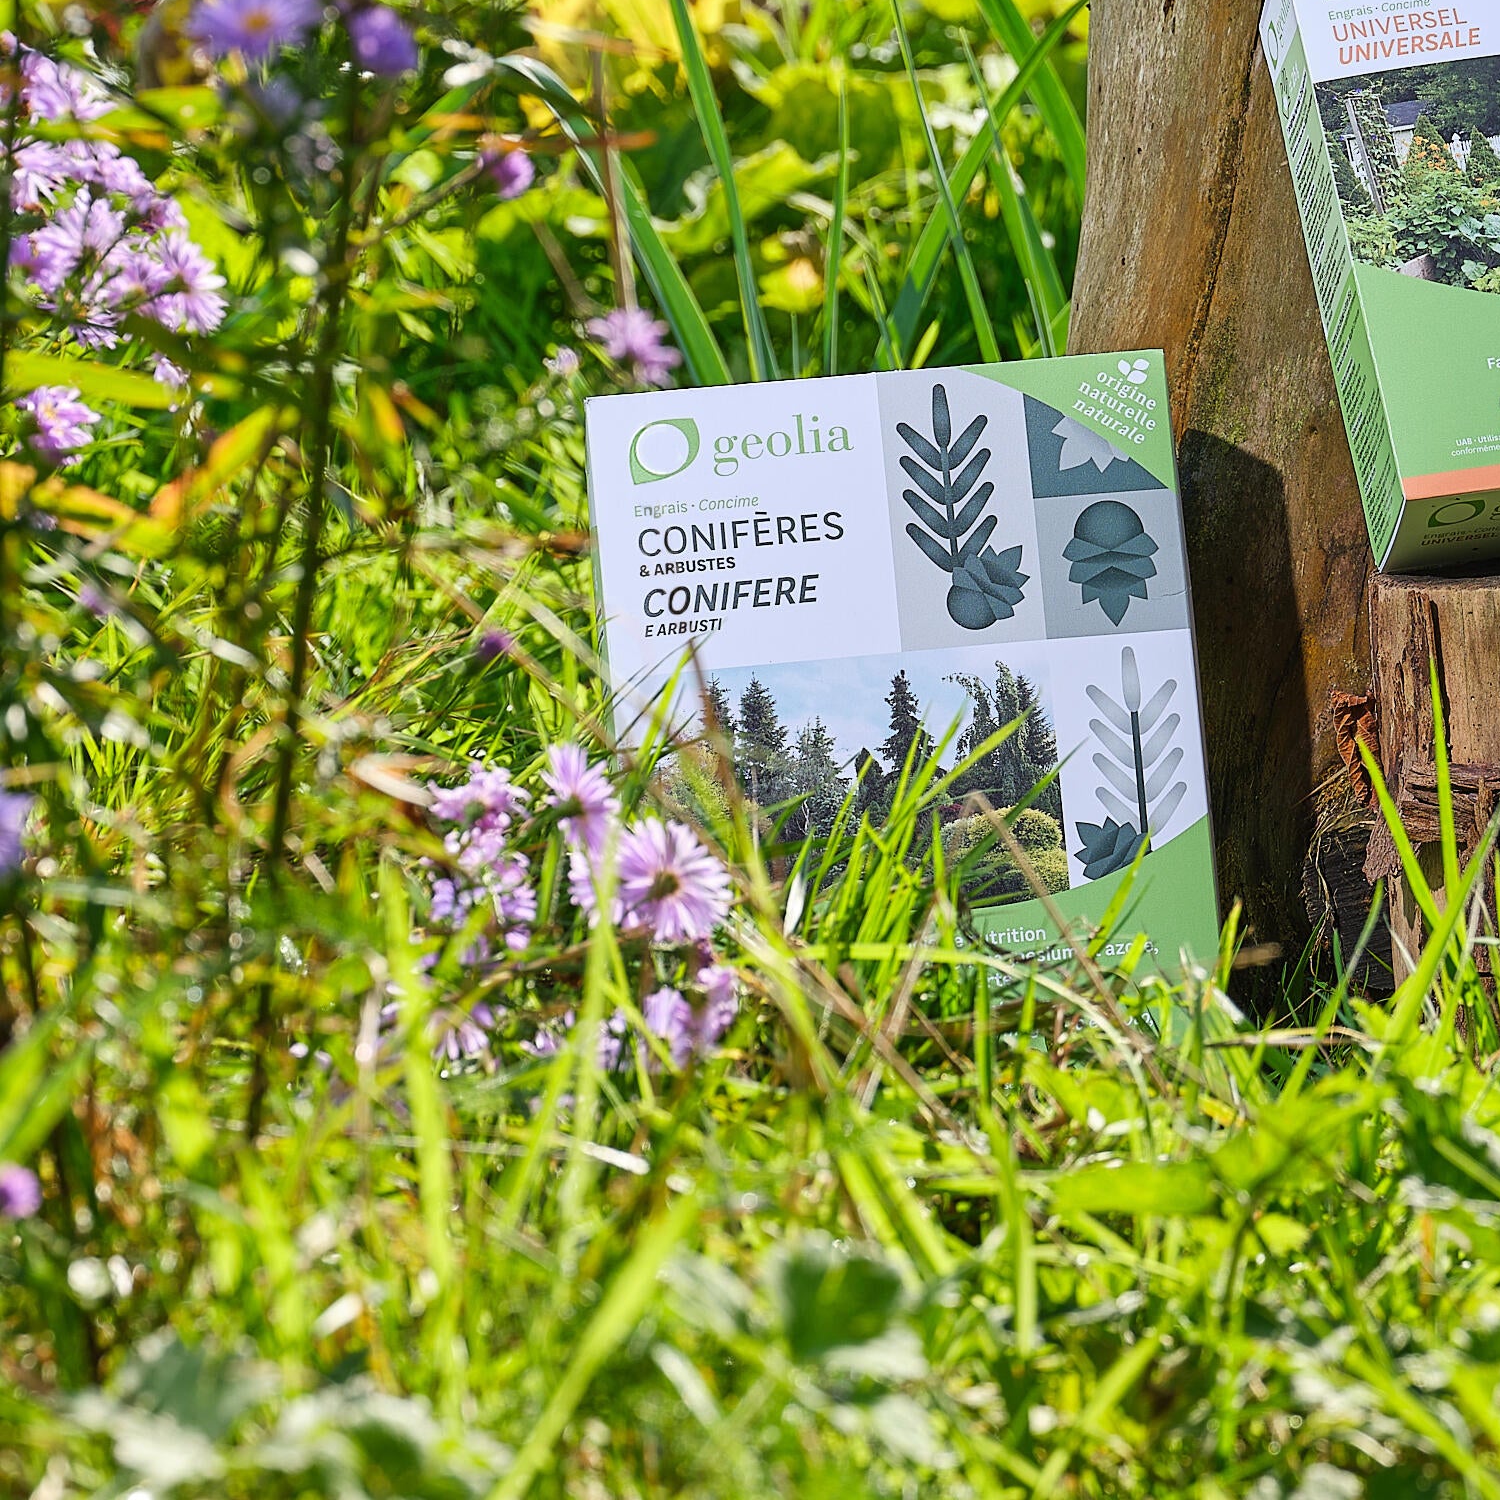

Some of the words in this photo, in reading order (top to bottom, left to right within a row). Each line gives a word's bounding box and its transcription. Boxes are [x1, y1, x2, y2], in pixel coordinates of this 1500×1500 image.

[1328, 5, 1372, 20] Engrais
[1332, 8, 1467, 41] UNIVERSEL
[1339, 28, 1480, 64] UNIVERSALE
[1078, 382, 1155, 430] naturelle
[1097, 372, 1156, 410] origine
[1072, 400, 1145, 443] naturale
[713, 413, 854, 476] geolia
[634, 500, 687, 518] Engrais
[699, 495, 759, 511] Concime
[639, 565, 649, 576] &
[654, 556, 735, 575] ARBUSTES
[644, 574, 818, 617] CONIFERE
[645, 624, 653, 637] E
[656, 618, 721, 636] ARBUSTI
